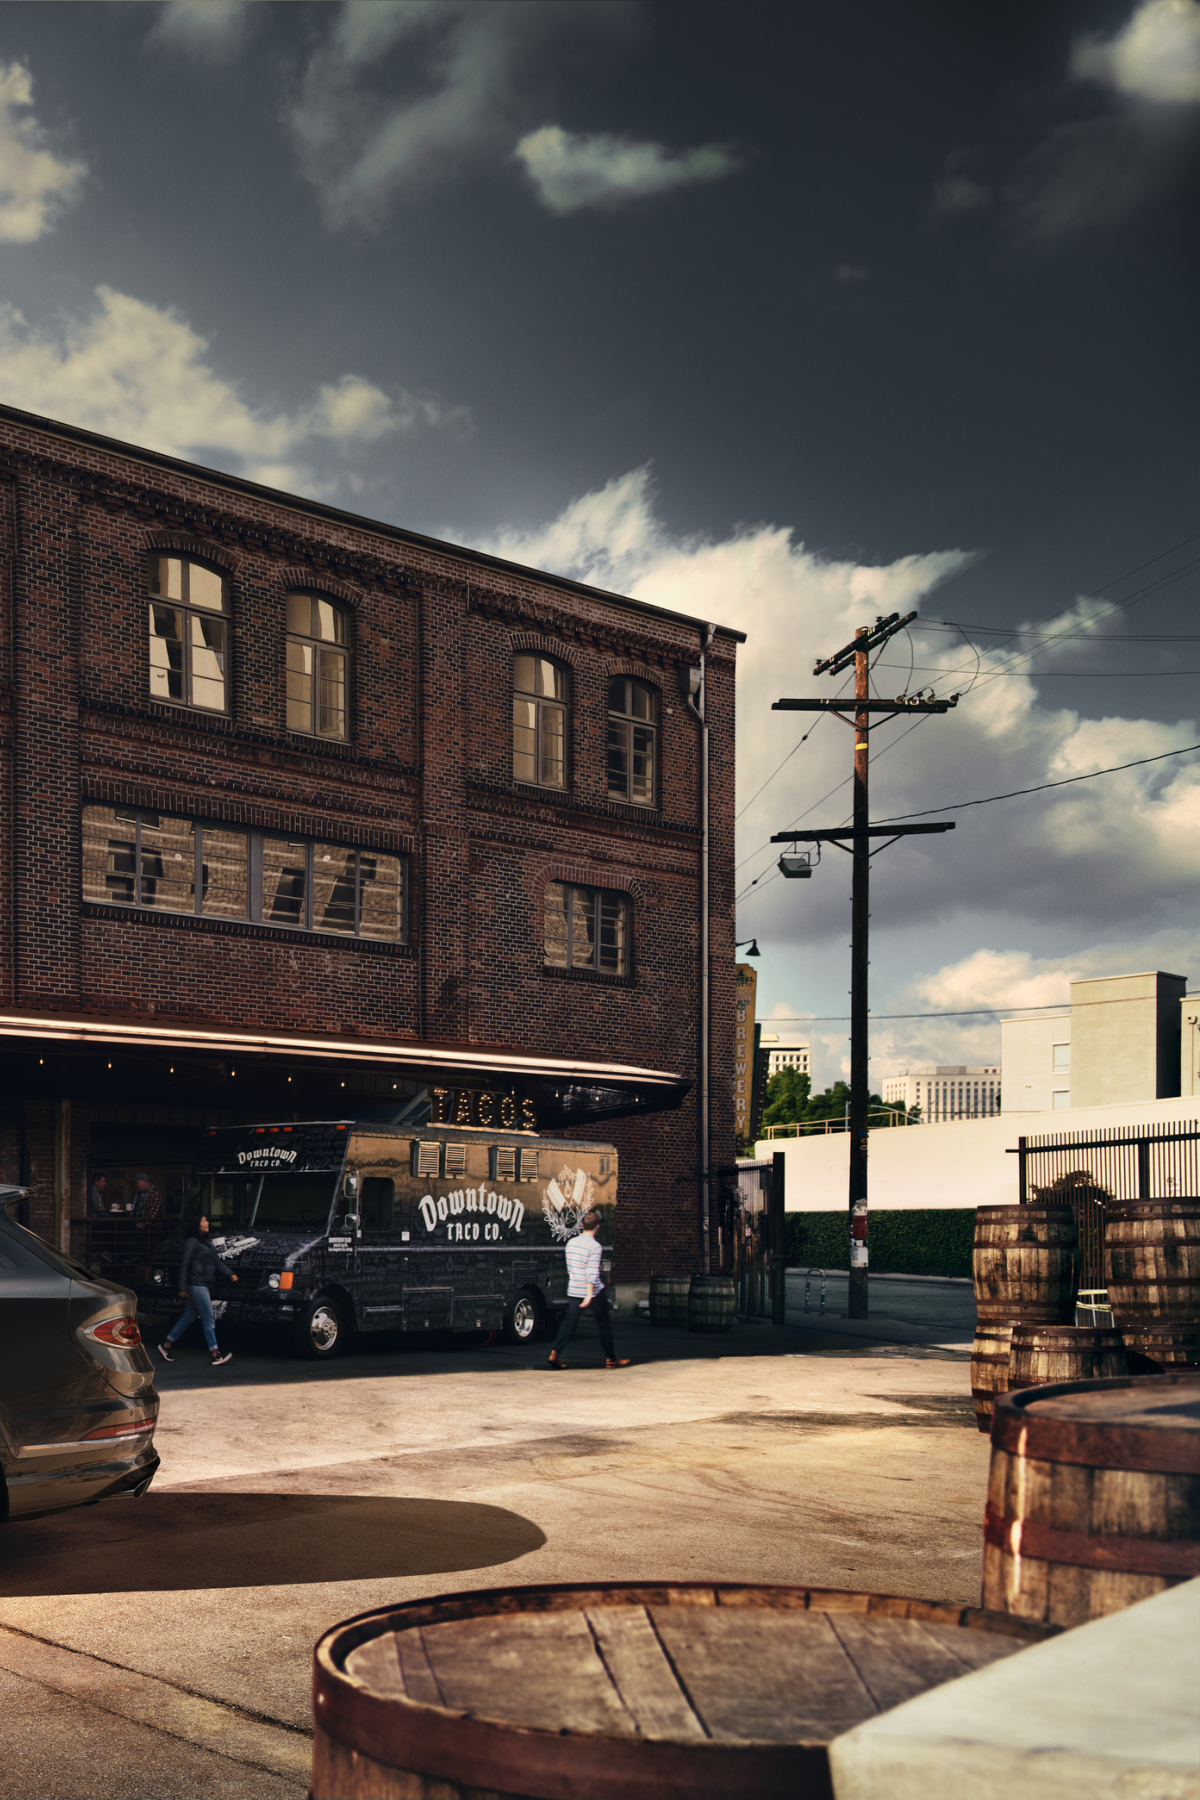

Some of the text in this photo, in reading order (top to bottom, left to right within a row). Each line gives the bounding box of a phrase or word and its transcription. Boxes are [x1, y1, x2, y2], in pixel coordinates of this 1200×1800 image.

[736, 1009, 748, 1129] BREWERY
[427, 1086, 537, 1130] TACOS
[237, 1146, 298, 1165] Downtown
[250, 1159, 282, 1168] TACO CO.
[418, 1181, 525, 1233] Downtown
[446, 1222, 503, 1243] TACO CO.
[362, 1284, 384, 1292] JALISCO
